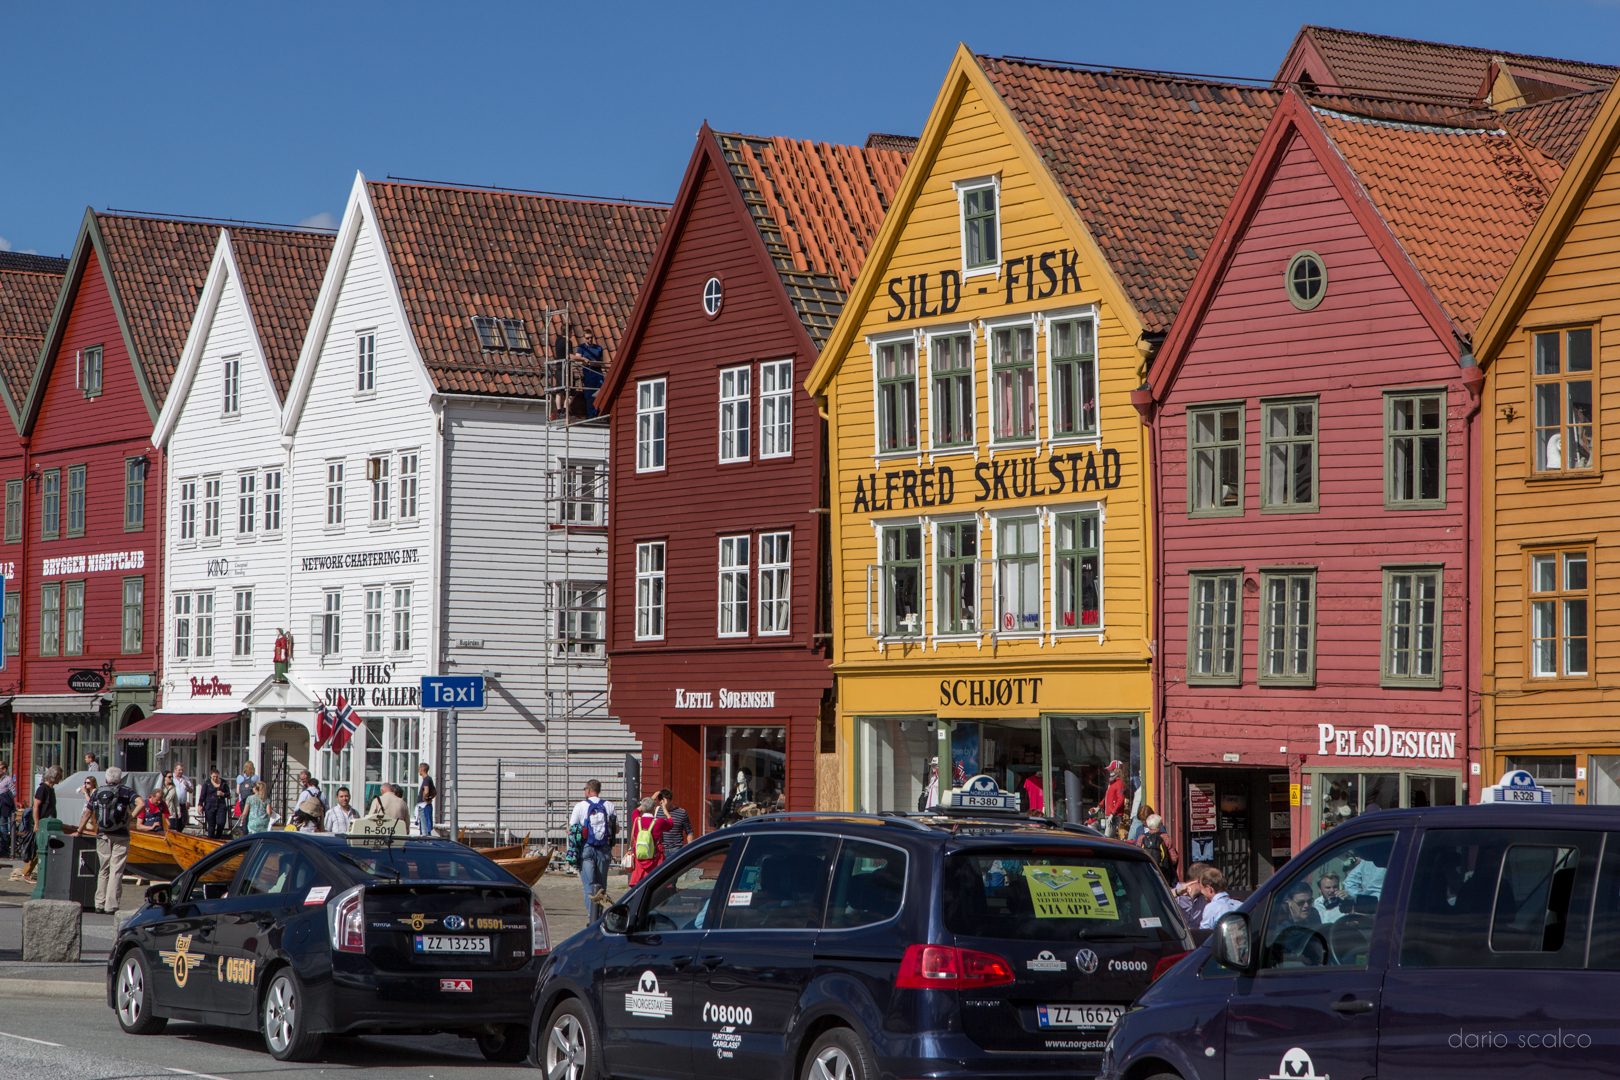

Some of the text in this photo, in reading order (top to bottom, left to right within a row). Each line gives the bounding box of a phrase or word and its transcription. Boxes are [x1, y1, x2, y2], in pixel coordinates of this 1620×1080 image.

[888, 270, 961, 322] SILD
[1004, 247, 1082, 304] FISK
[853, 448, 1121, 513] ALFRED SKULSTAD
[42, 550, 145, 576] BRYGGEN NIGHTCLUB
[302, 549, 419, 571] NETWORK CHARTERING INT.
[1064, 609, 1099, 626] NOWAY
[371, 685, 420, 707] GALLER
[430, 681, 475, 702] Taxi
[675, 687, 775, 709] KJETIL SØRENSEN
[940, 677, 1043, 706] SCHJØTT
[968, 797, 998, 806] R-380
[1513, 791, 1534, 801] R-328
[1039, 904, 1063, 915] VIA
[1066, 904, 1092, 915] APP
[477, 917, 503, 930] 05501
[427, 936, 485, 951] ZZ 13255
[177, 957, 184, 977] 1
[226, 956, 256, 986] 05501
[1114, 960, 1148, 971] 08000
[442, 981, 471, 991] BA
[632, 997, 665, 1011] NORGESTAXI
[710, 1004, 753, 1026] 08000
[1053, 1007, 1122, 1023] ZZ 16629
[1045, 1039, 1107, 1050] www.norgestax
